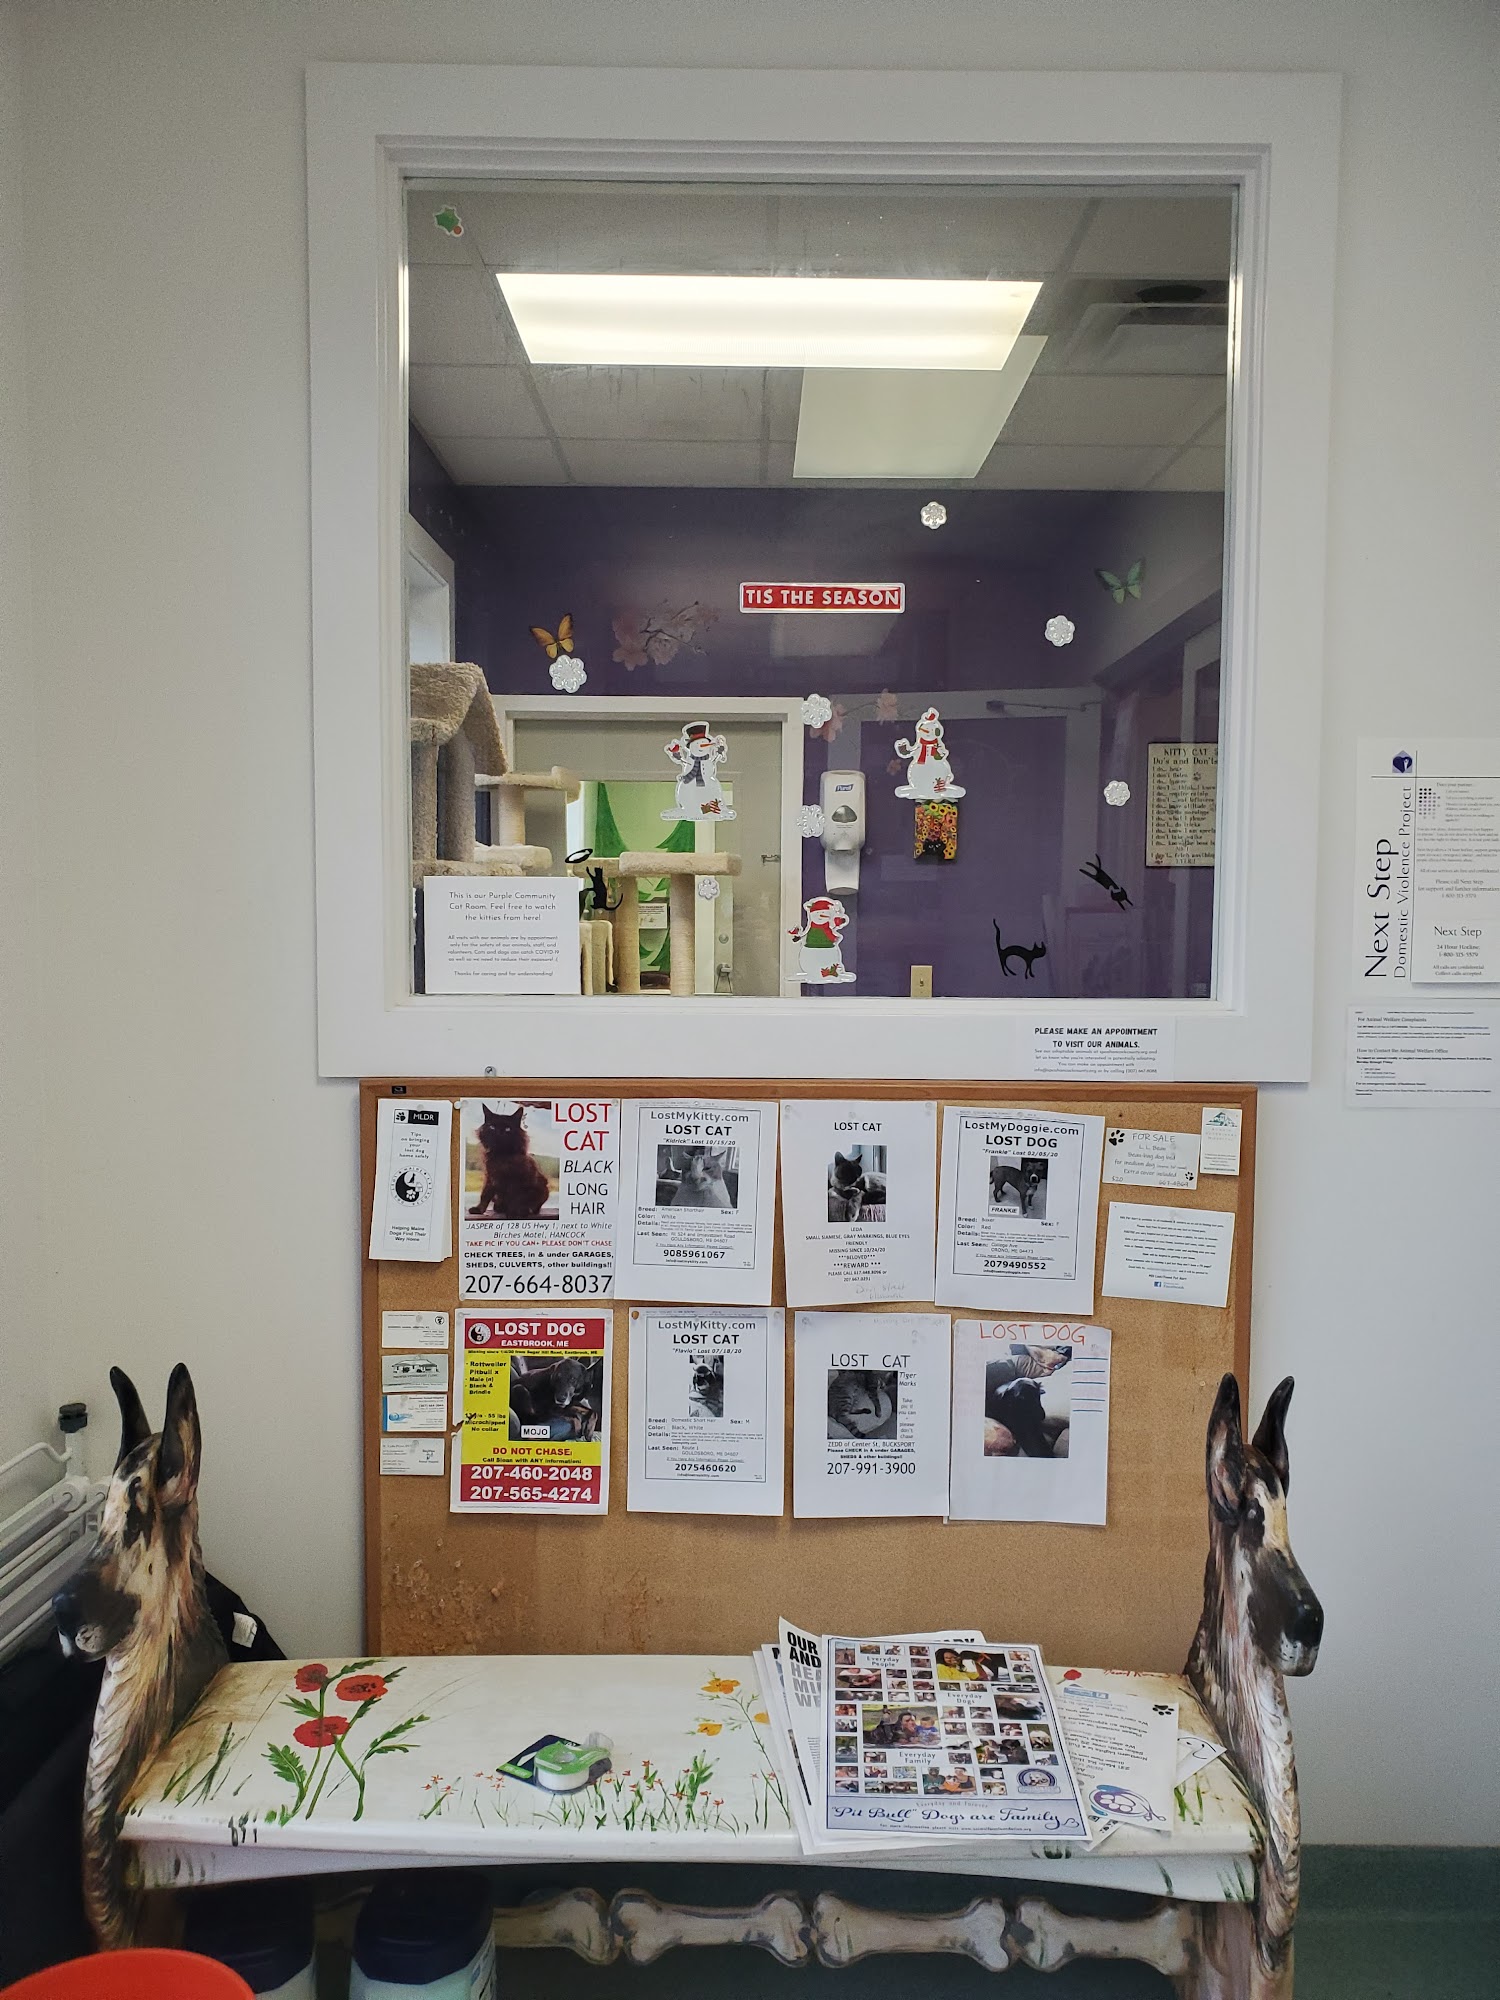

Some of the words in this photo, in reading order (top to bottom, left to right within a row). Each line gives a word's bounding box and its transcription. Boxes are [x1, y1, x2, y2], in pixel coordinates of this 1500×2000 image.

[746, 589, 773, 604] TIS
[781, 590, 813, 604] THE
[822, 590, 898, 605] SEASON
[1398, 787, 1414, 836] Project
[1367, 838, 1399, 900] Step
[1397, 842, 1410, 904] Violence
[489, 892, 512, 900] Purple
[515, 892, 556, 900] Community
[1434, 926, 1457, 936] Next
[1460, 926, 1482, 939] Step
[1364, 912, 1390, 978] Next
[1394, 909, 1409, 978] Domestic
[555, 1103, 612, 1122] LOST
[650, 1111, 749, 1122] LostMyKitty.com
[666, 1125, 701, 1135] LOST
[706, 1126, 732, 1136] CAT
[834, 1122, 860, 1131] LOST
[862, 1122, 882, 1132] CAT
[965, 1121, 1079, 1135] LostMyDoggie.com
[564, 1131, 609, 1151] CAT
[986, 1135, 1022, 1146] LOST
[1027, 1137, 1058, 1148] DOG
[1132, 1133, 1150, 1141] FOR
[1153, 1134, 1176, 1142] SALE
[564, 1160, 614, 1173] BLACK
[567, 1183, 608, 1196] LONG
[571, 1202, 605, 1214] HAIR
[663, 1250, 725, 1259] 9085961067
[984, 1260, 1046, 1270] 2079490552
[465, 1275, 613, 1294] 207-664-8037
[494, 1323, 541, 1335] LOST
[547, 1323, 586, 1336] DOG
[658, 1320, 756, 1331] LostMyKitty.com
[673, 1334, 708, 1344] LOST
[713, 1335, 739, 1344] CAT
[979, 1323, 1032, 1340] LOST
[1042, 1324, 1086, 1345] DOG
[831, 1354, 869, 1367] LOST
[882, 1355, 910, 1368] CAT
[470, 1466, 592, 1481] 207-460-2048
[675, 1463, 736, 1472] 2075460620
[827, 1463, 916, 1474] 207-991-3900
[470, 1486, 592, 1501] 207-565-4274
[787, 1631, 818, 1655] OUR
[790, 1647, 821, 1668] AND
[869, 1808, 917, 1823] Bull"
[921, 1809, 965, 1825] Dogs
[970, 1813, 996, 1821] are
[999, 1807, 1060, 1830] Family
